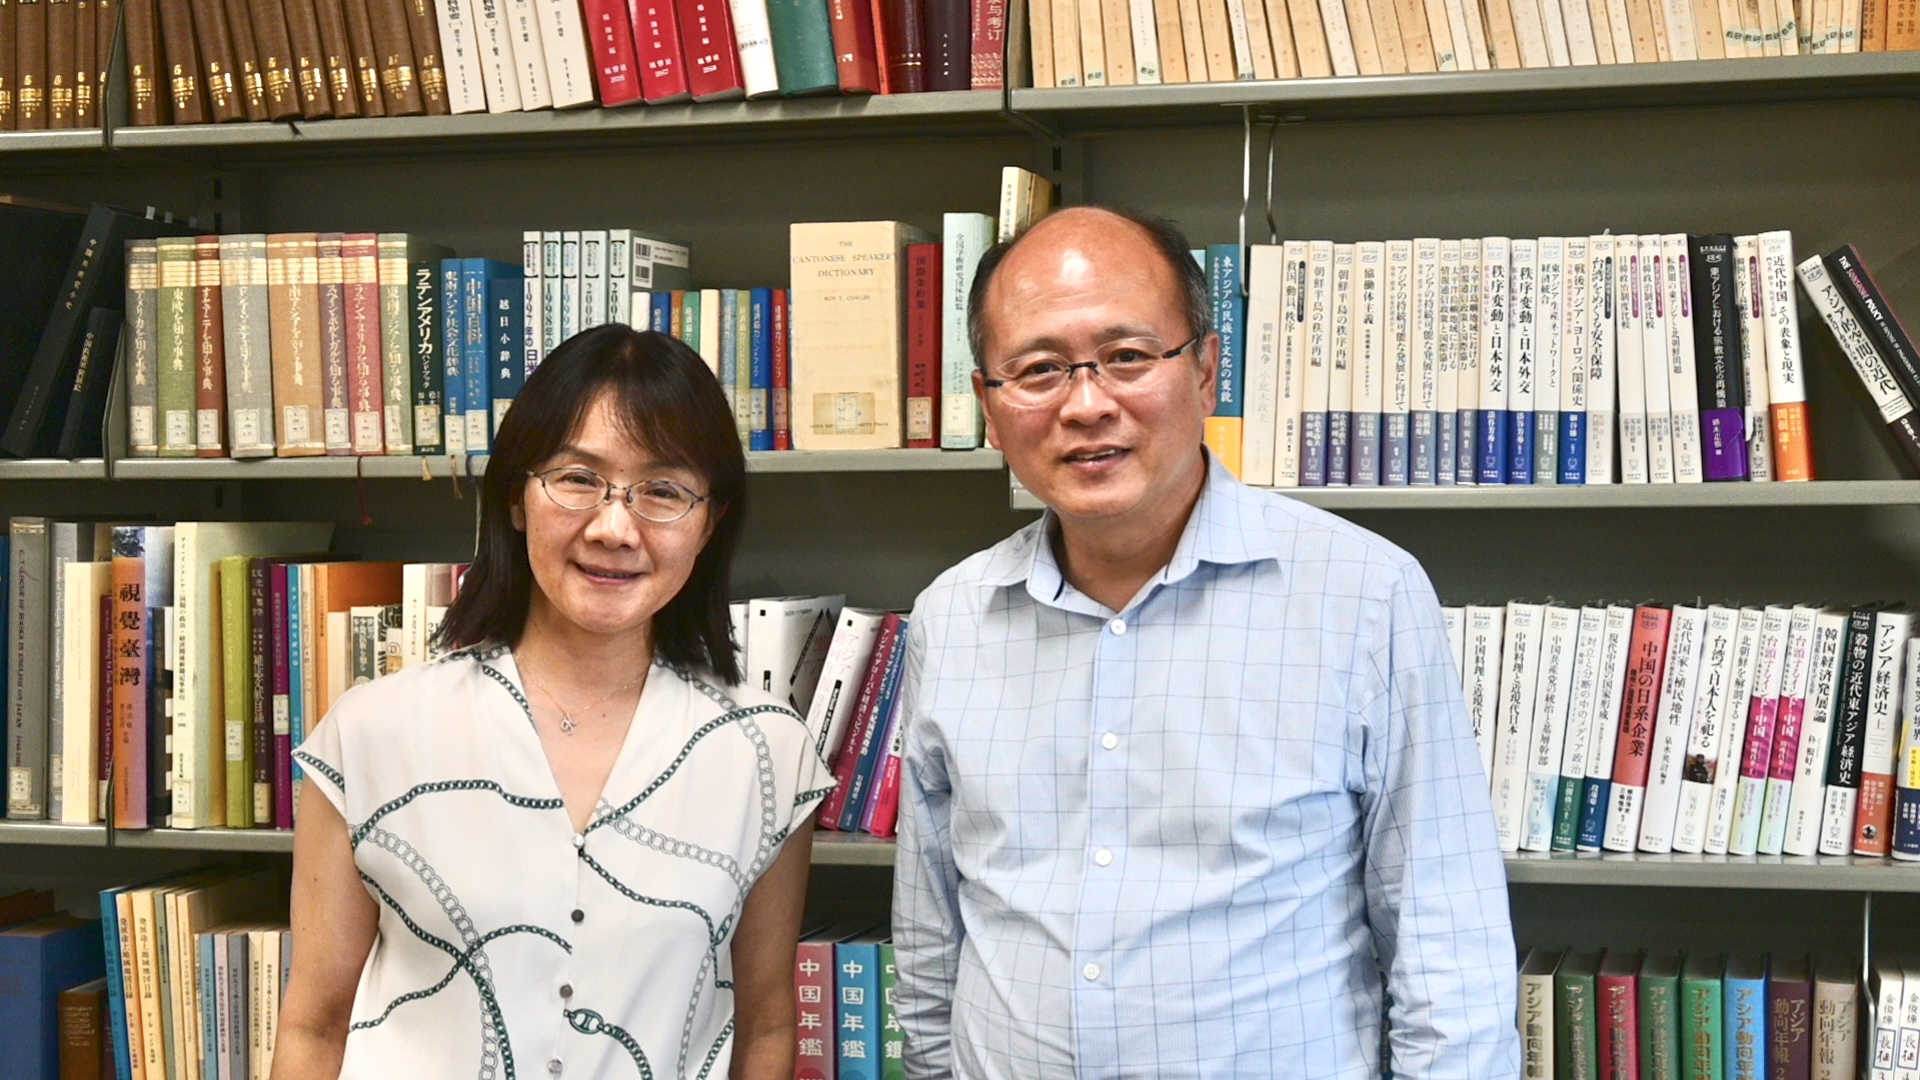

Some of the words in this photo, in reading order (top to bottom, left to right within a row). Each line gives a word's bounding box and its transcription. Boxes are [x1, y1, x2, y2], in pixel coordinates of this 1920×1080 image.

[986, 0, 1003, 40] 与考订
[792, 255, 846, 264] CANTONESE
[817, 267, 875, 277] DICTIONARY
[1363, 266, 1376, 325] 協働体主義
[1540, 263, 1551, 305] 経済統合
[1619, 255, 1631, 329] 日韓政治制度比較
[1643, 255, 1655, 329] 日韓政治制度比較
[1773, 255, 1788, 302] 近代中国
[134, 289, 147, 386] アメリカを知る事典
[353, 284, 371, 412] ラテンアメリカを知る事典
[415, 268, 433, 355] ラテンアメリカ
[499, 298, 512, 379] 越日小辞典
[1219, 256, 1234, 403] 東アジアの民族と文化の変貌
[1310, 266, 1325, 368] 朝鮮半島の秩序再編
[1335, 269, 1350, 370] 朝鮮半島の秩序再編
[1394, 265, 1408, 411] アジアの持続可能な発展に向けて
[1422, 263, 1435, 409] アジアの持続可能な発展に向けて
[1489, 264, 1505, 393] 秩序変動と日本外交
[1517, 266, 1534, 395] 秩序変動と日本外交
[1549, 263, 1560, 388] 東アジア生産ネットワークと
[1572, 263, 1587, 406] 戦後アジア・ヨーロッパ関係史
[1589, 256, 1605, 380] 台湾をめぐる安全保障
[1778, 306, 1795, 384] その表象と現実
[1821, 284, 1896, 395] アジア的空間の近代
[1864, 298, 1884, 322] POLICY
[18, 549, 26, 597] CTALOGUE
[119, 583, 141, 686] 視覺臺灣
[1507, 631, 1527, 735] 中国料理と近現代日本
[1599, 632, 1619, 720] 現代中国の国家形成
[1668, 617, 1694, 727] 近代国家と植民地性
[1731, 634, 1752, 720] 北朝鮮を解剖する
[1813, 627, 1838, 723] 韓国経済発展論
[1873, 624, 1896, 716] アジア経済史
[1472, 634, 1487, 738] 中国料理と近現代日本
[1538, 634, 1562, 766] 中国共産党の統治と基層幹部
[1570, 636, 1597, 775] 対立と分断の中のメディア政治
[1628, 641, 1658, 757] 中国の日系企業
[1700, 634, 1727, 747] 台湾で日本人を祀る
[1752, 635, 1778, 738] 台頭するインド・中国
[1781, 635, 1807, 738] 台頭するインド・中国
[1838, 633, 1869, 785] 穀物の近代東アジア経済史
[798, 958, 824, 1056] 中国年鑑
[841, 959, 866, 1059] 中国年鑑
[1525, 982, 1544, 1078] アジア動向年報
[1774, 998, 1790, 1064] 動向年報
[1790, 999, 1806, 1043] アジア
[1819, 1000, 1836, 1065] 動向年報
[1837, 1001, 1853, 1043] アジア
